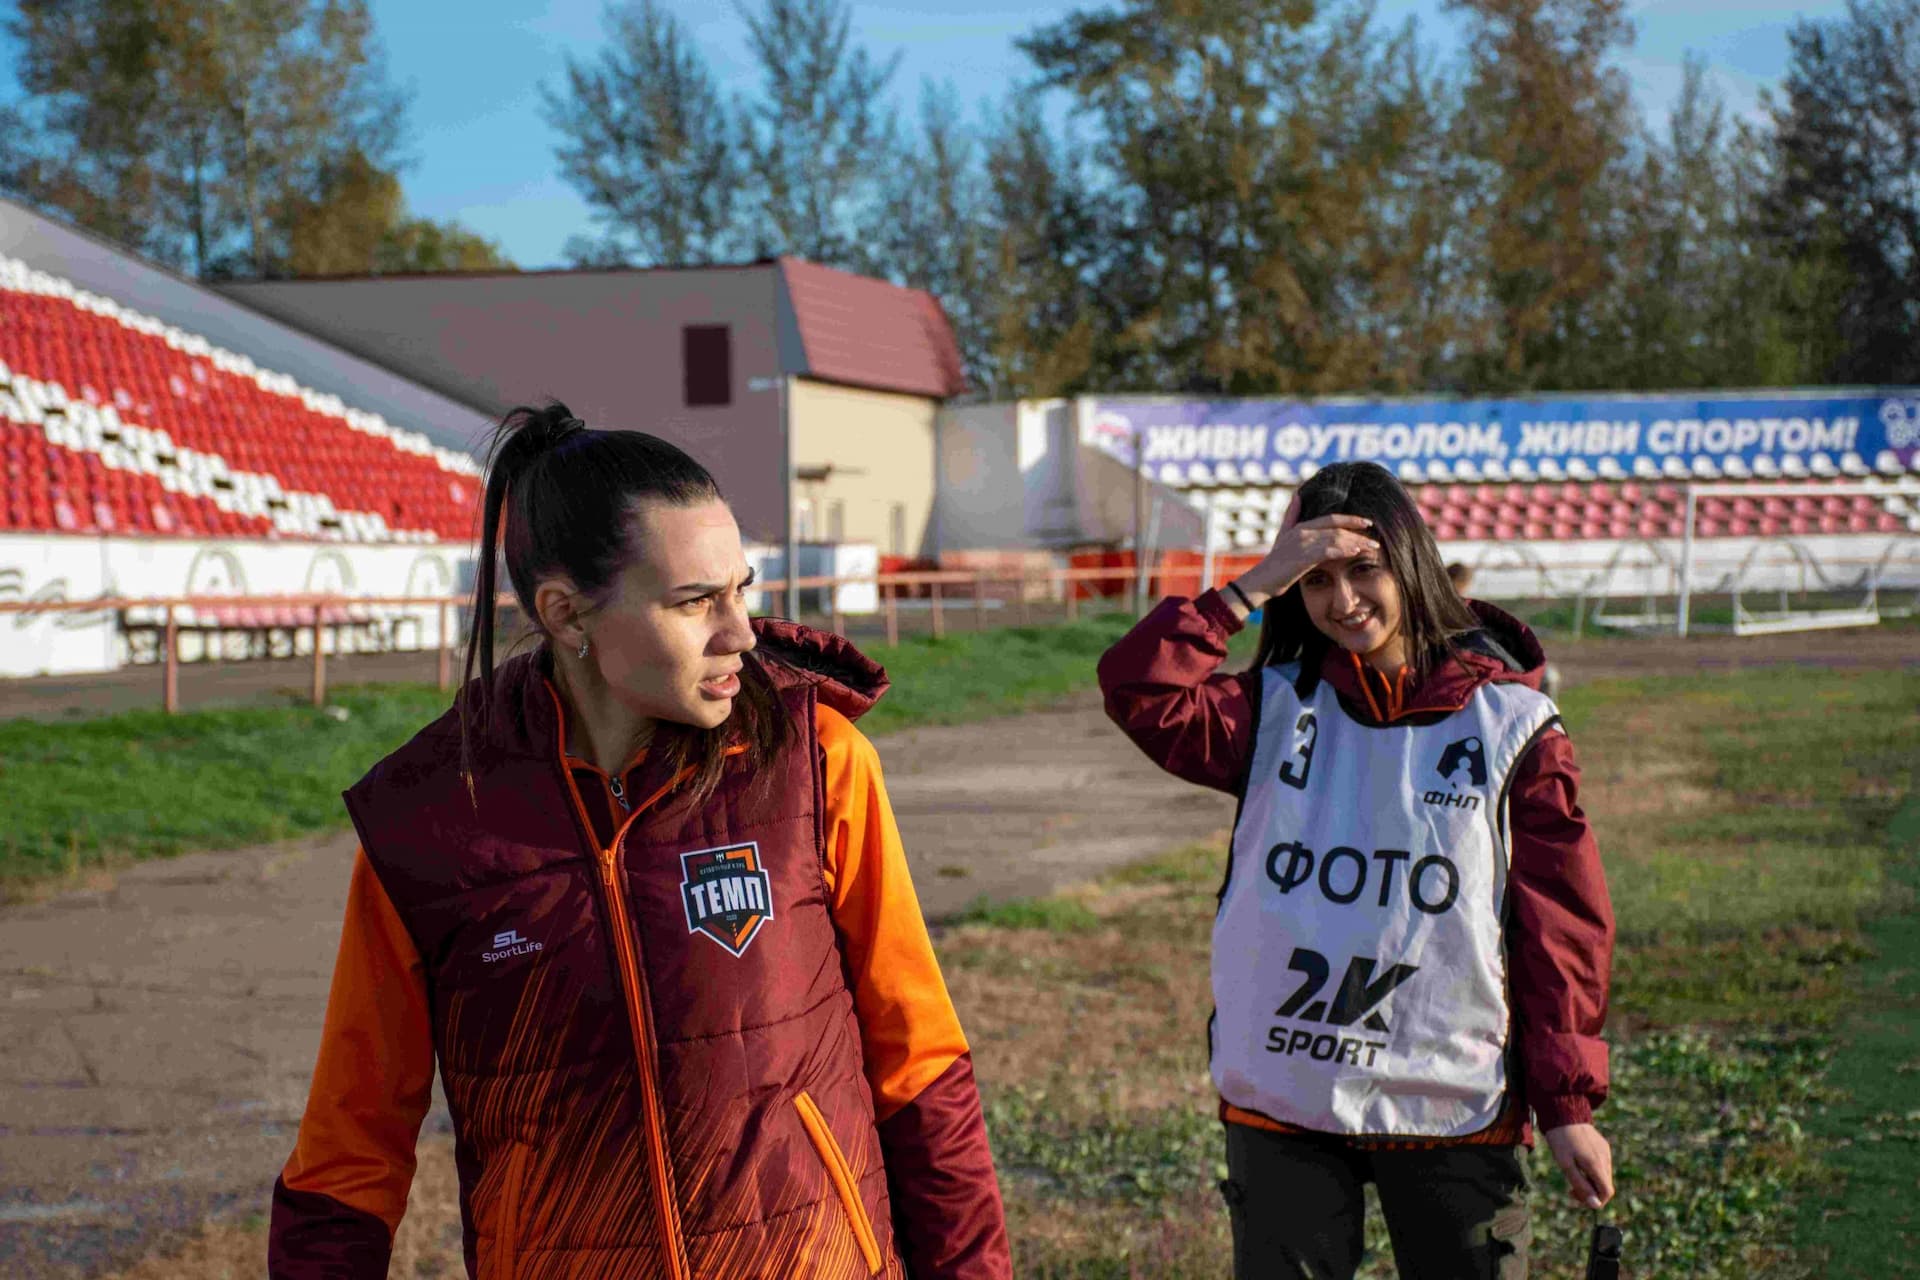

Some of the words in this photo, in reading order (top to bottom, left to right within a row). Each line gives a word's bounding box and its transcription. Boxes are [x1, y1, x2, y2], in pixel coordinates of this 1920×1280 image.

[1146, 423, 1268, 460] ЖИВИ
[1274, 421, 1508, 460] ФУТБОЛОМ,
[1517, 421, 1640, 455] ЖИВИ
[1647, 416, 1859, 454] СПОРТОМ!
[1279, 713, 1317, 790] 3
[690, 876, 765, 920] ТЕМП
[1266, 840, 1459, 915] ФОТО
[482, 941, 544, 963] SportLife
[493, 930, 527, 949] SL
[1275, 947, 1420, 1033] 2K
[1266, 1026, 1387, 1067] SPORT
